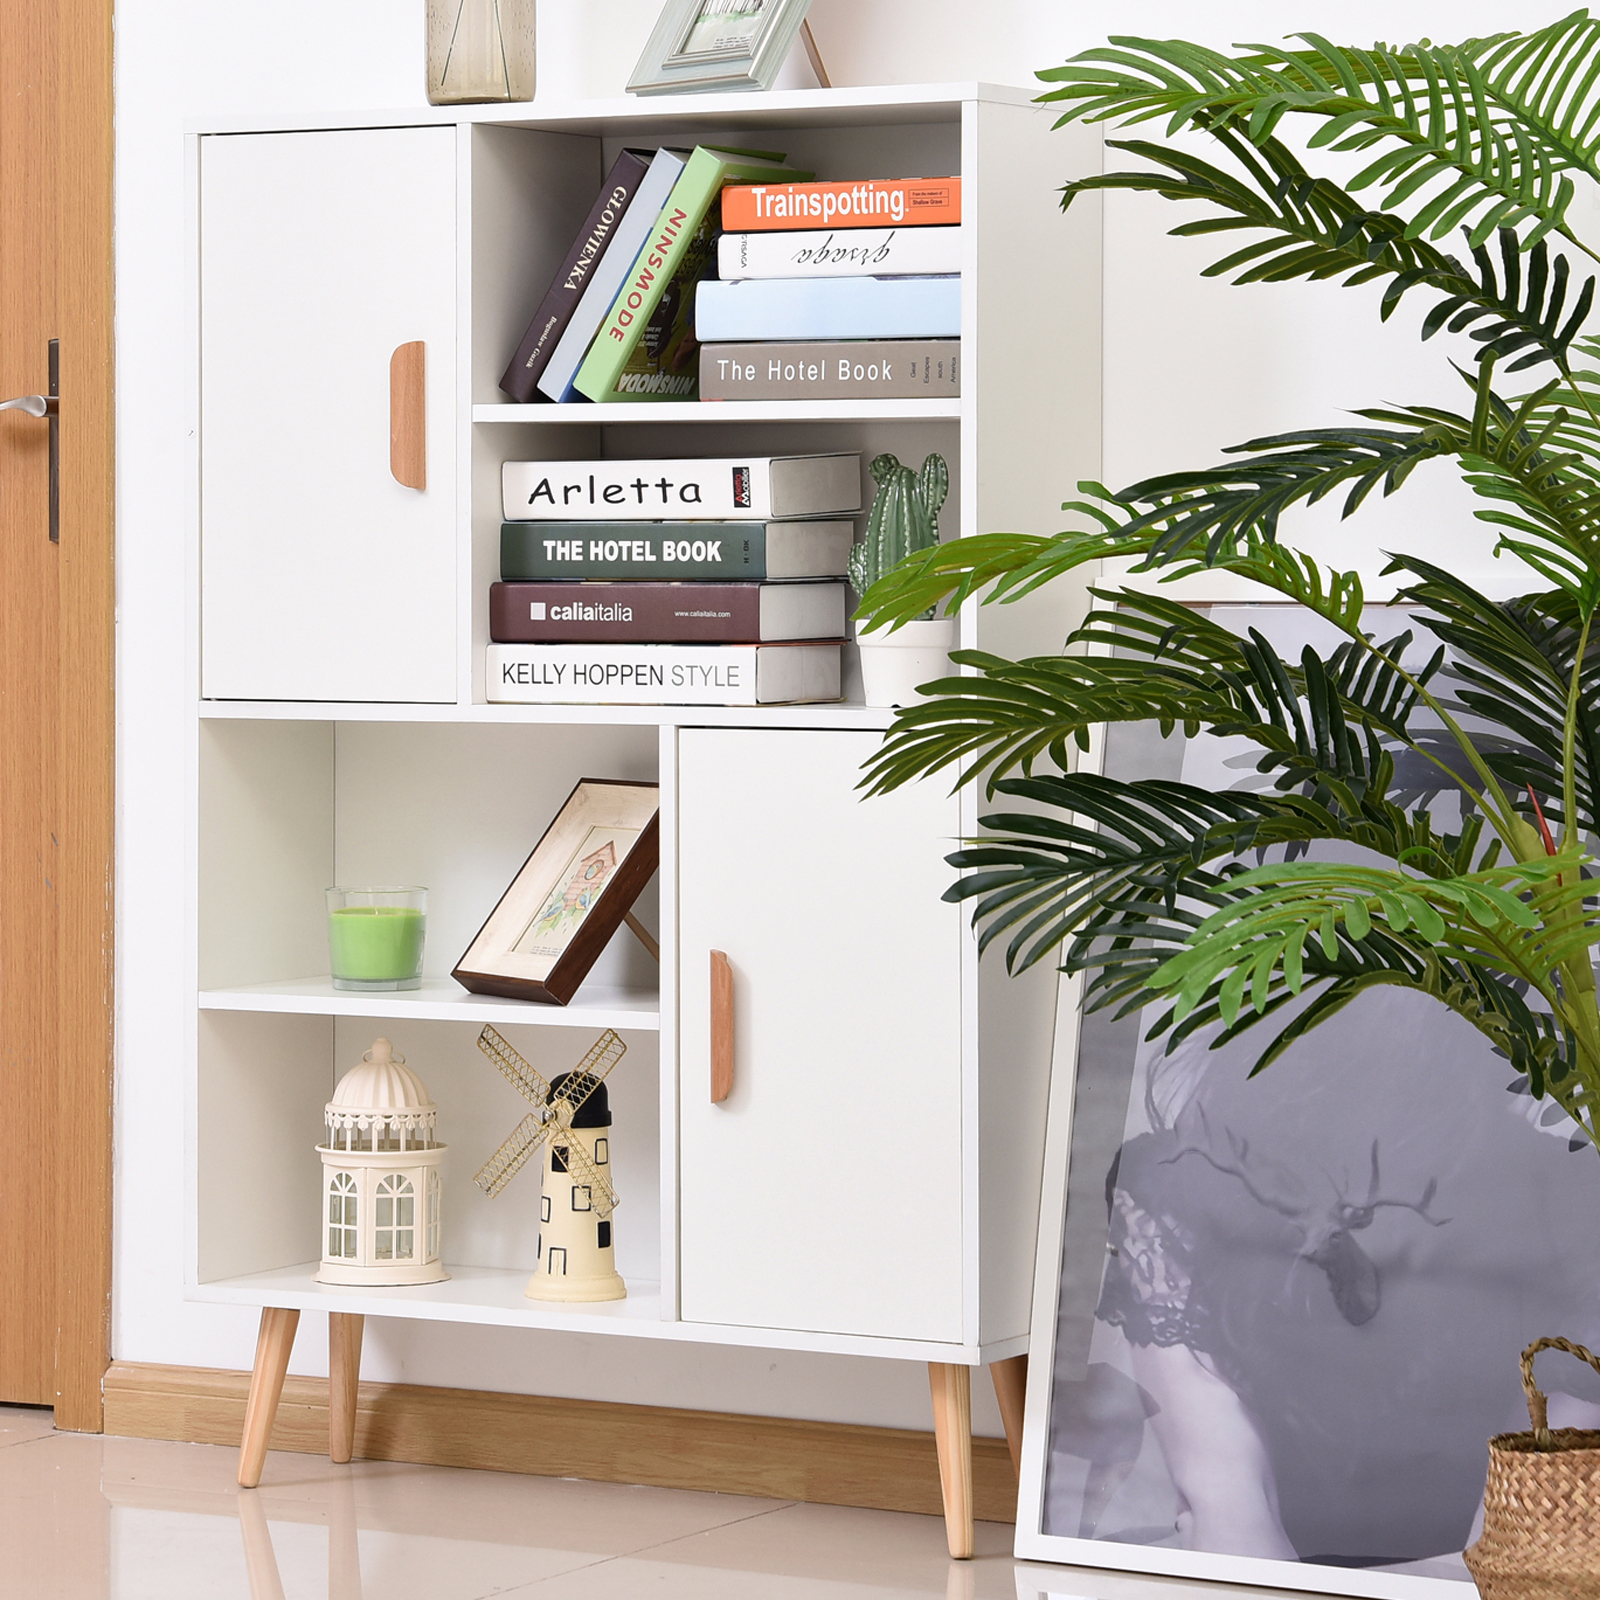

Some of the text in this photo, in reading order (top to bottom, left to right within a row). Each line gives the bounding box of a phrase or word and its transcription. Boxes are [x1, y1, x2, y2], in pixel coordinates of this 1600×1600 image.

[609, 207, 688, 342] NINSMODE
[717, 359, 892, 381] The Hotel Book
[528, 474, 702, 505] Arletta
[543, 540, 722, 562] THE HOTEL BOOK
[550, 602, 633, 622] caliaitalia
[502, 663, 740, 687] KELLY HOPPEN STYLE
